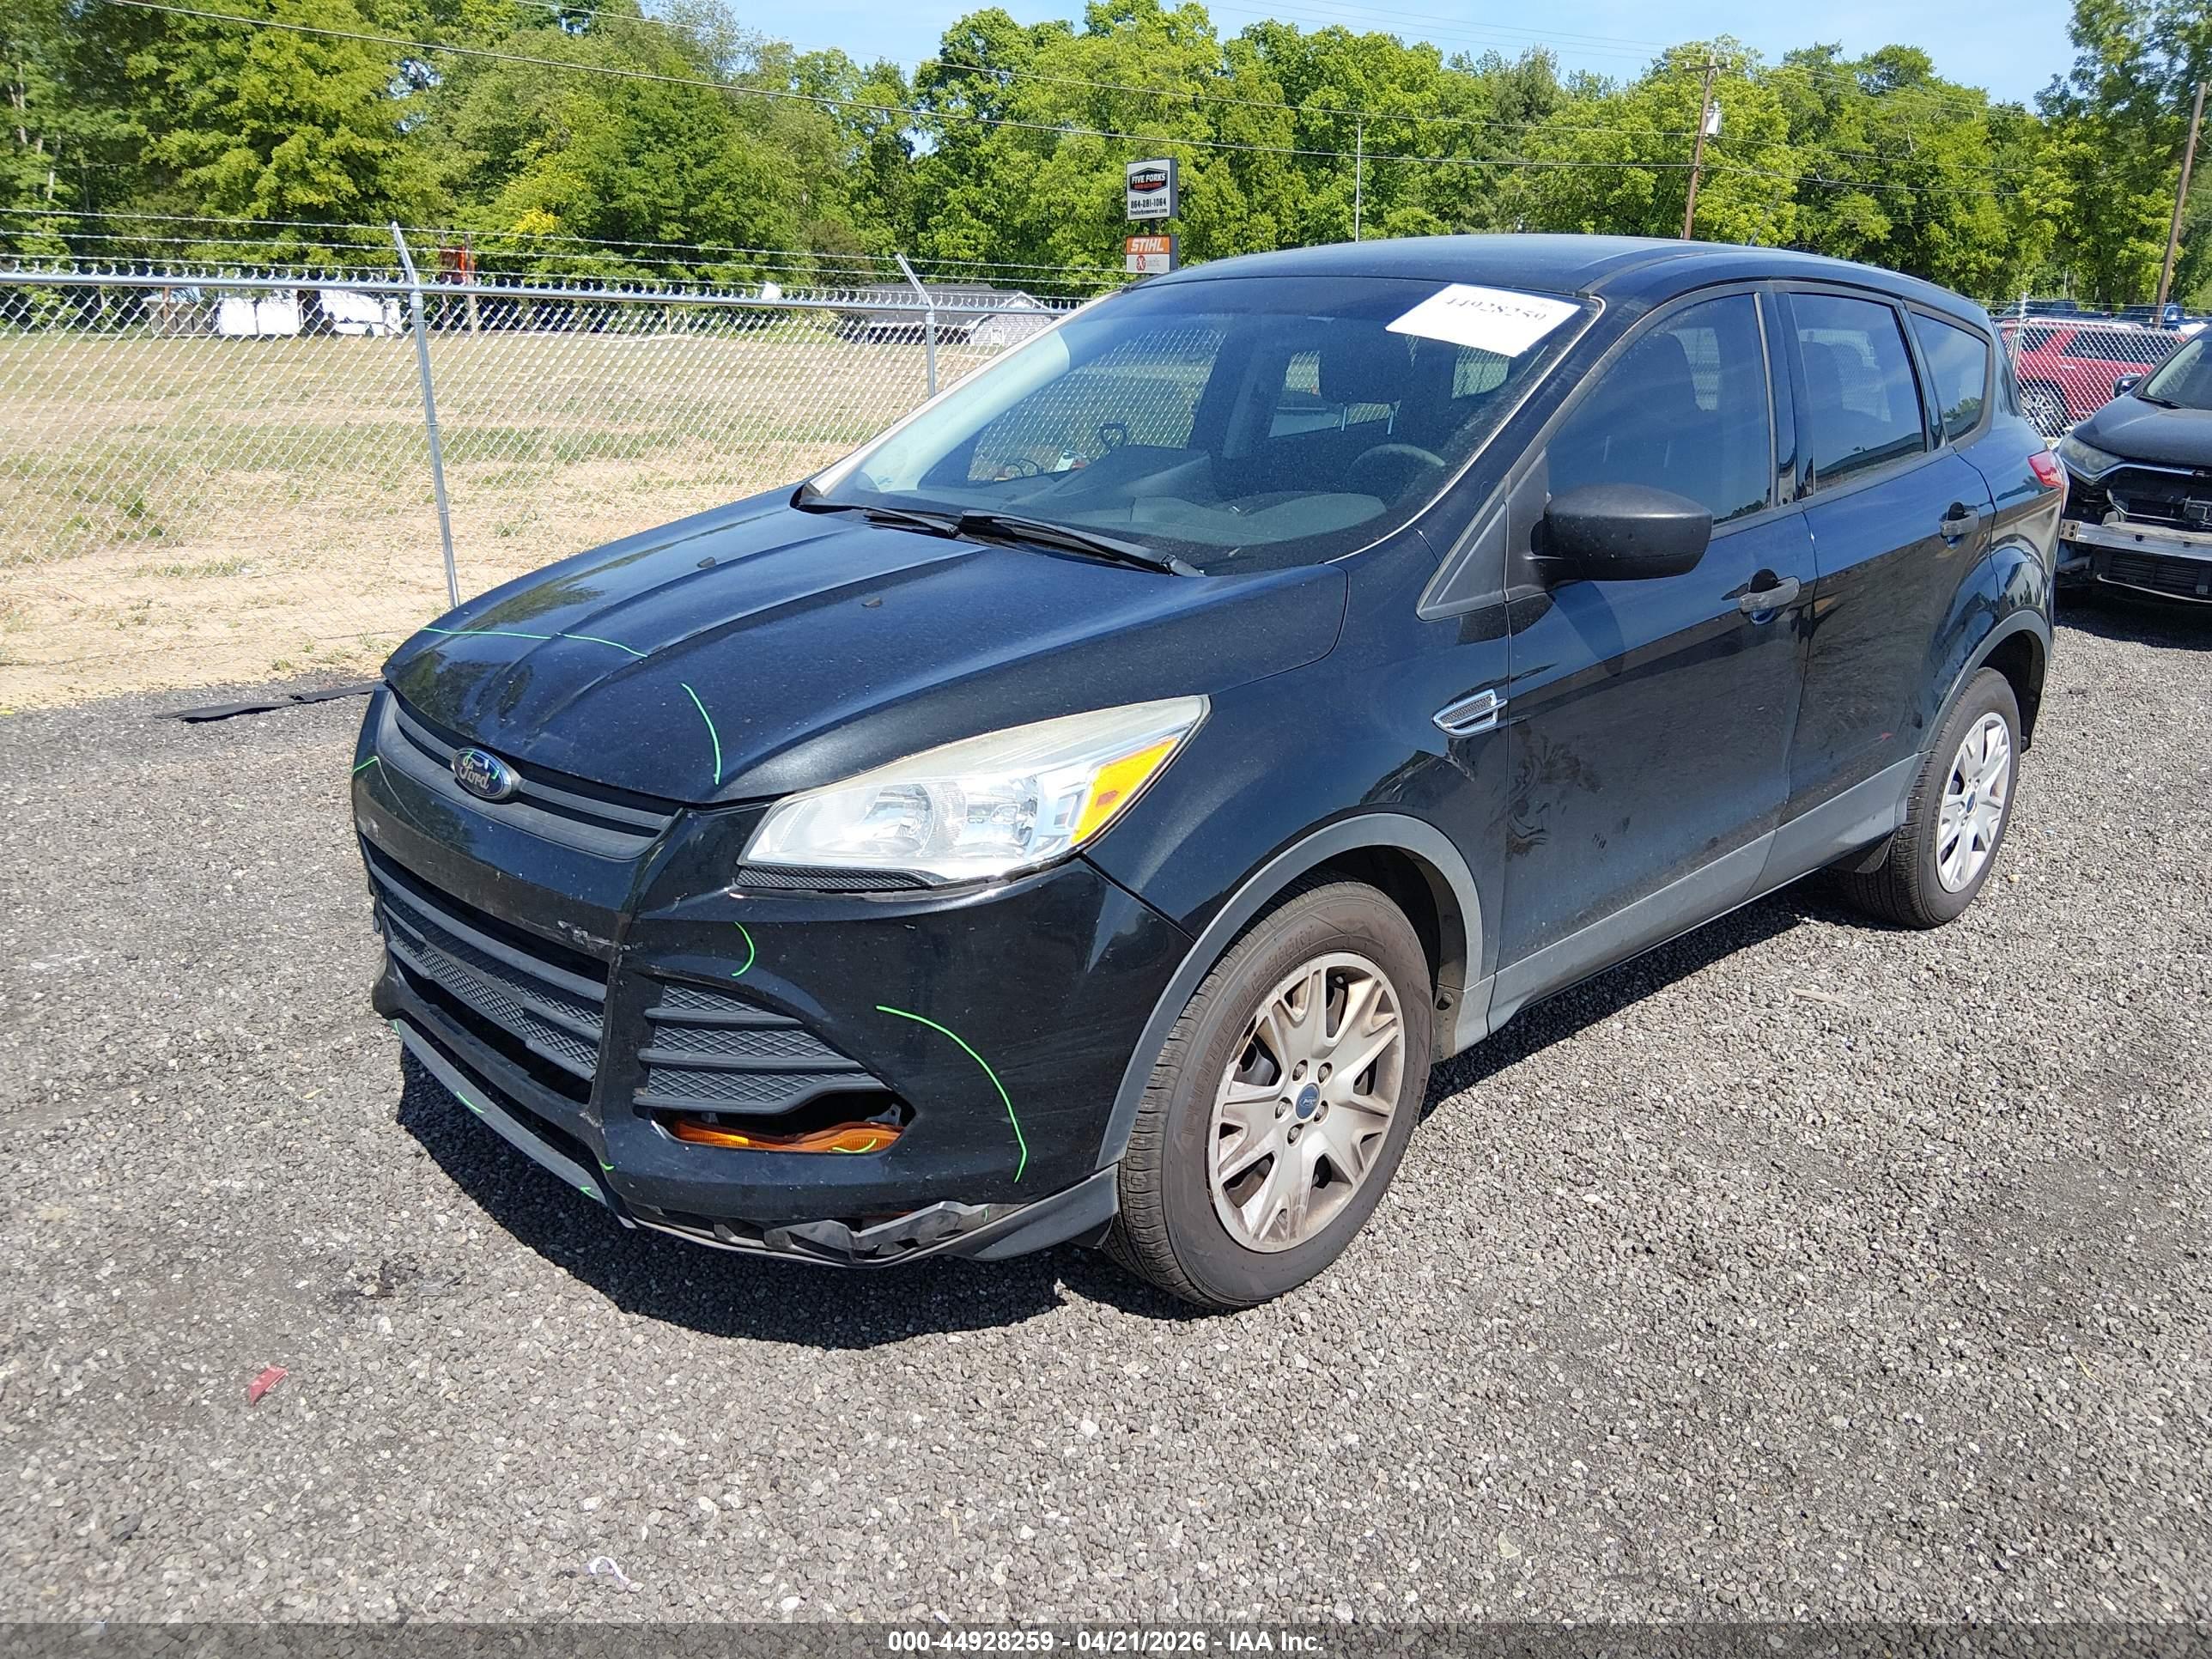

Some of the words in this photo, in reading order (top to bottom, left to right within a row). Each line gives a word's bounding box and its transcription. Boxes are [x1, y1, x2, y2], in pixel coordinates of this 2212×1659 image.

[1132, 175, 1145, 185] FIVE
[1146, 173, 1165, 182] FORKS
[1131, 238, 1164, 252] STIHL
[459, 754, 490, 790] Ford
